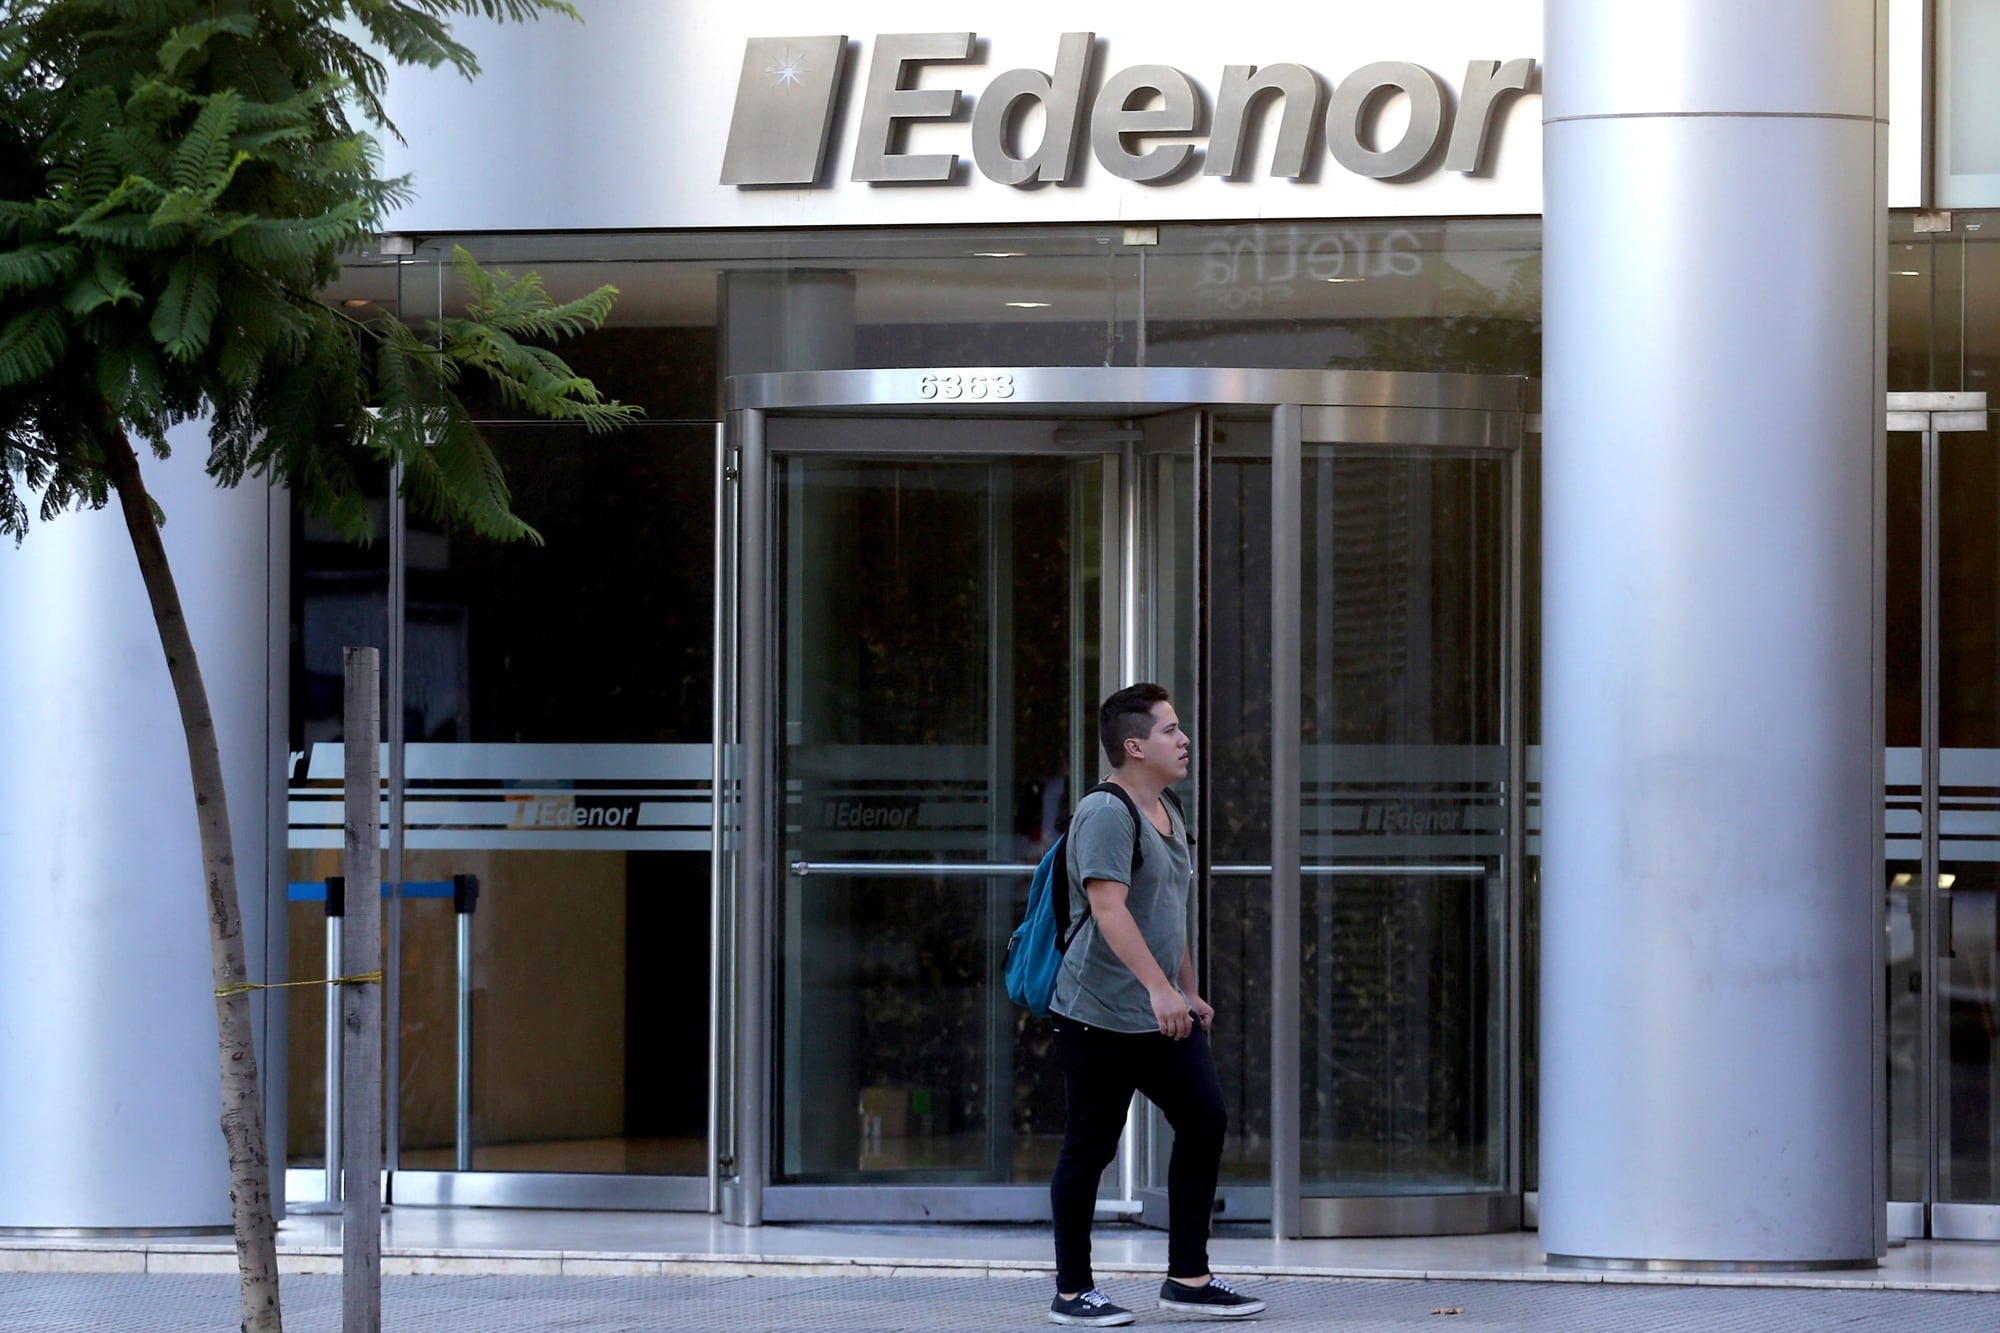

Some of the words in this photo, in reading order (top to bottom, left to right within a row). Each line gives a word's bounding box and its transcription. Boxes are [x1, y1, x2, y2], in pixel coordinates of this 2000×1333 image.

[851, 31, 1536, 186] Edenor
[919, 374, 1015, 400] 6363
[541, 802, 633, 827] Edenor
[836, 802, 912, 827] Edenor
[1382, 803, 1460, 830] Edenor
